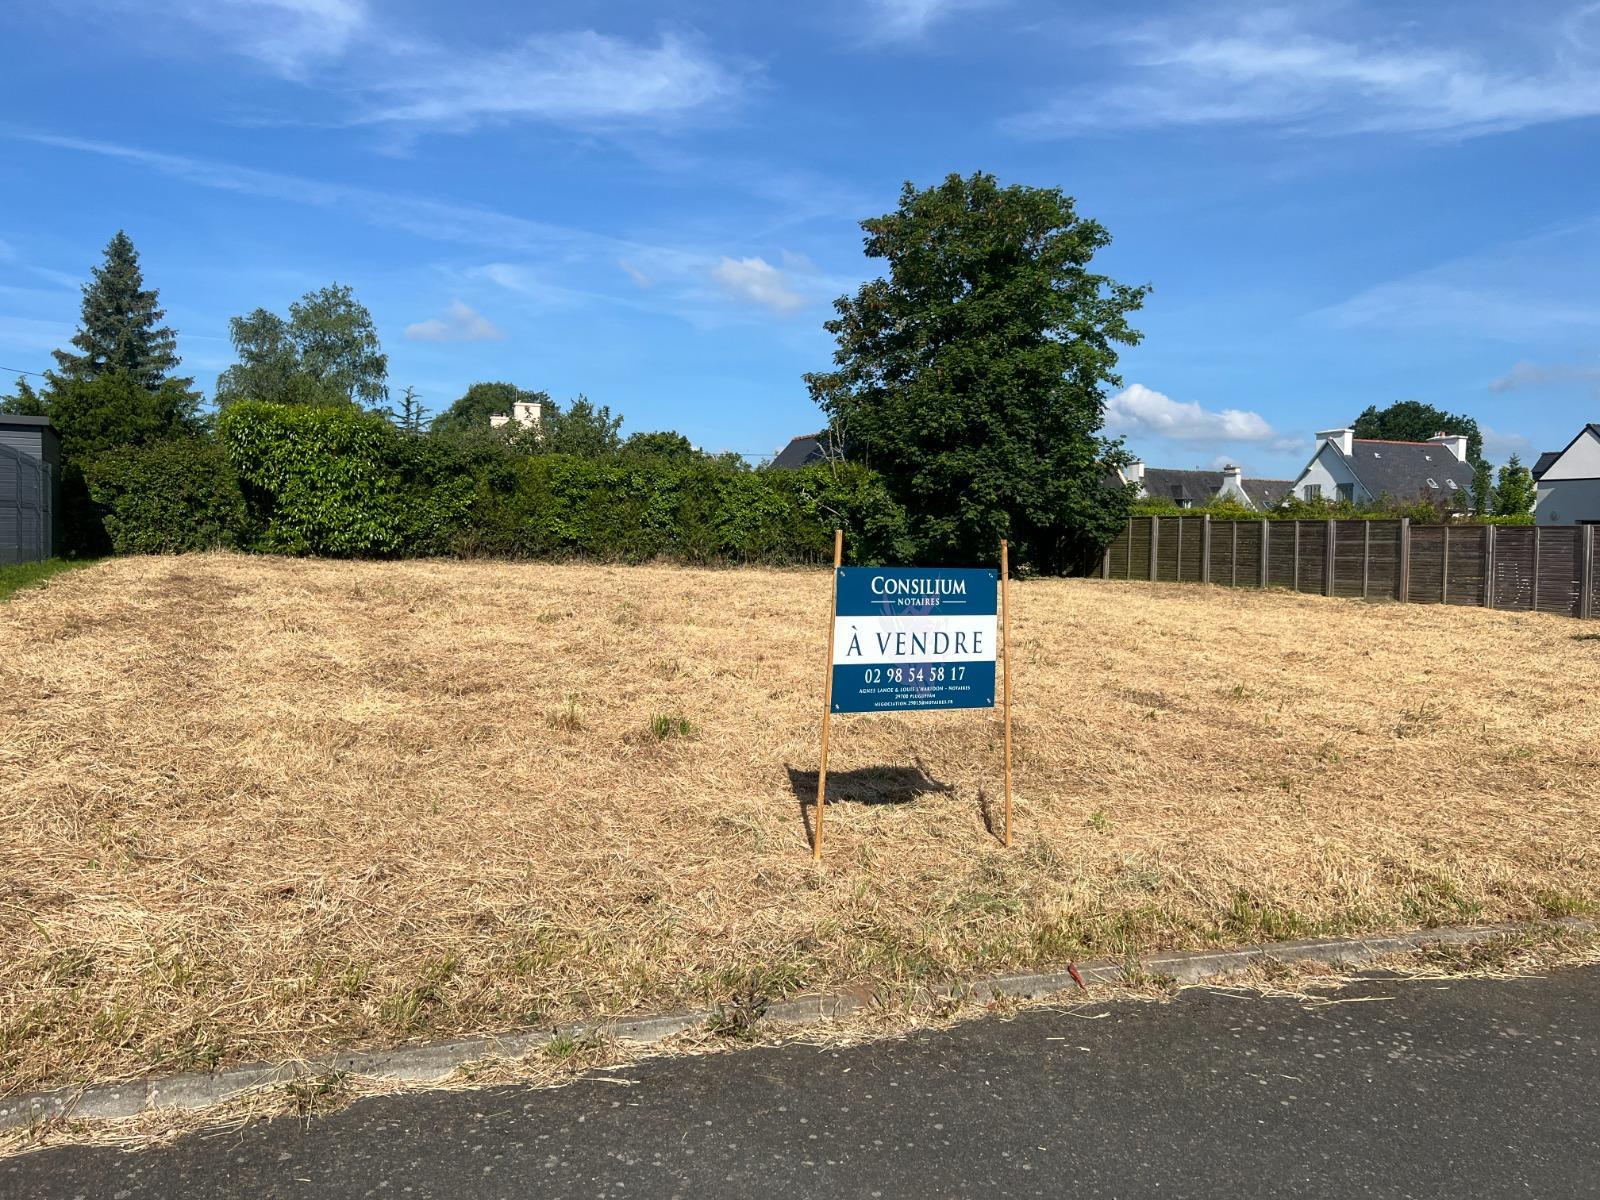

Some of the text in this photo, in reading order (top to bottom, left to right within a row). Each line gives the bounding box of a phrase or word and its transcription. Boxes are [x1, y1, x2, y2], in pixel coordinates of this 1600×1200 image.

[871, 576, 967, 595] CONSILIUM
[897, 598, 940, 606] NOTAIRES
[846, 625, 983, 657] À VENDRE
[864, 666, 966, 684] 02 98 54 58 17
